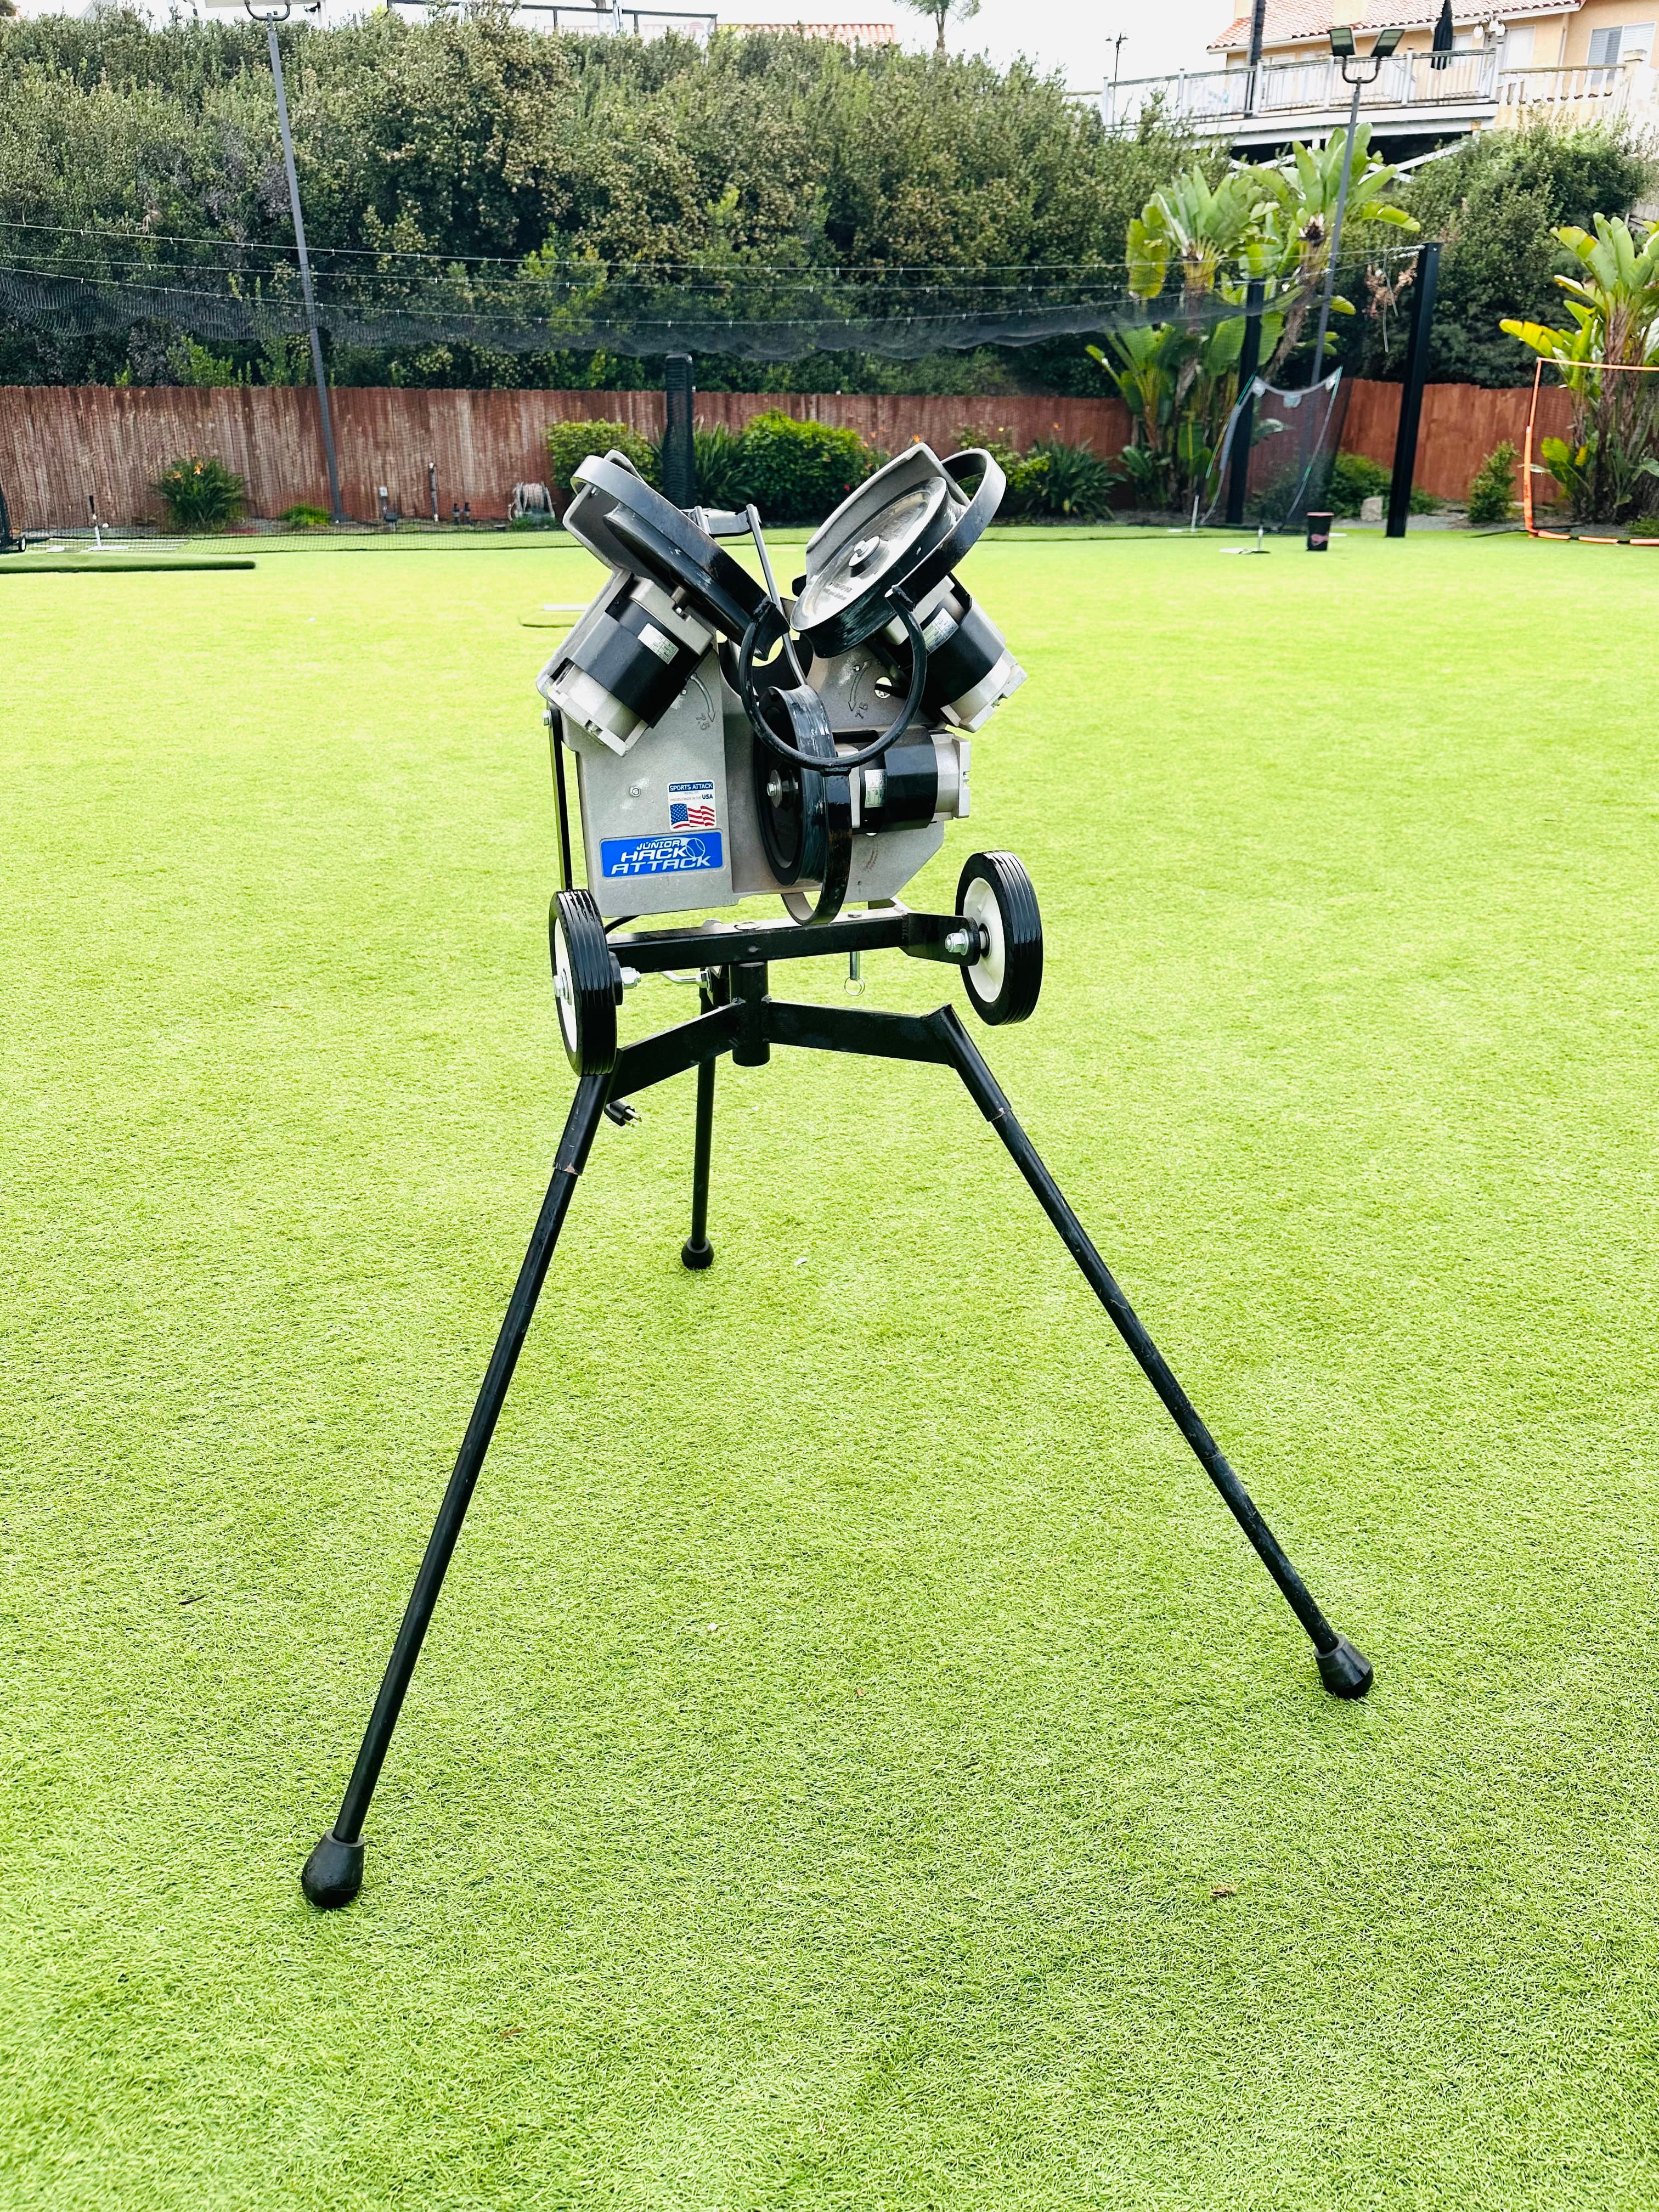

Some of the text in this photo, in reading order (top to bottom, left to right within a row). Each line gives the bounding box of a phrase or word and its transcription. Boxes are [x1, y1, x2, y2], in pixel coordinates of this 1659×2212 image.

[636, 840, 681, 850] JUNIOR
[620, 847, 687, 862] HACK
[611, 856, 712, 875] ATTACK
